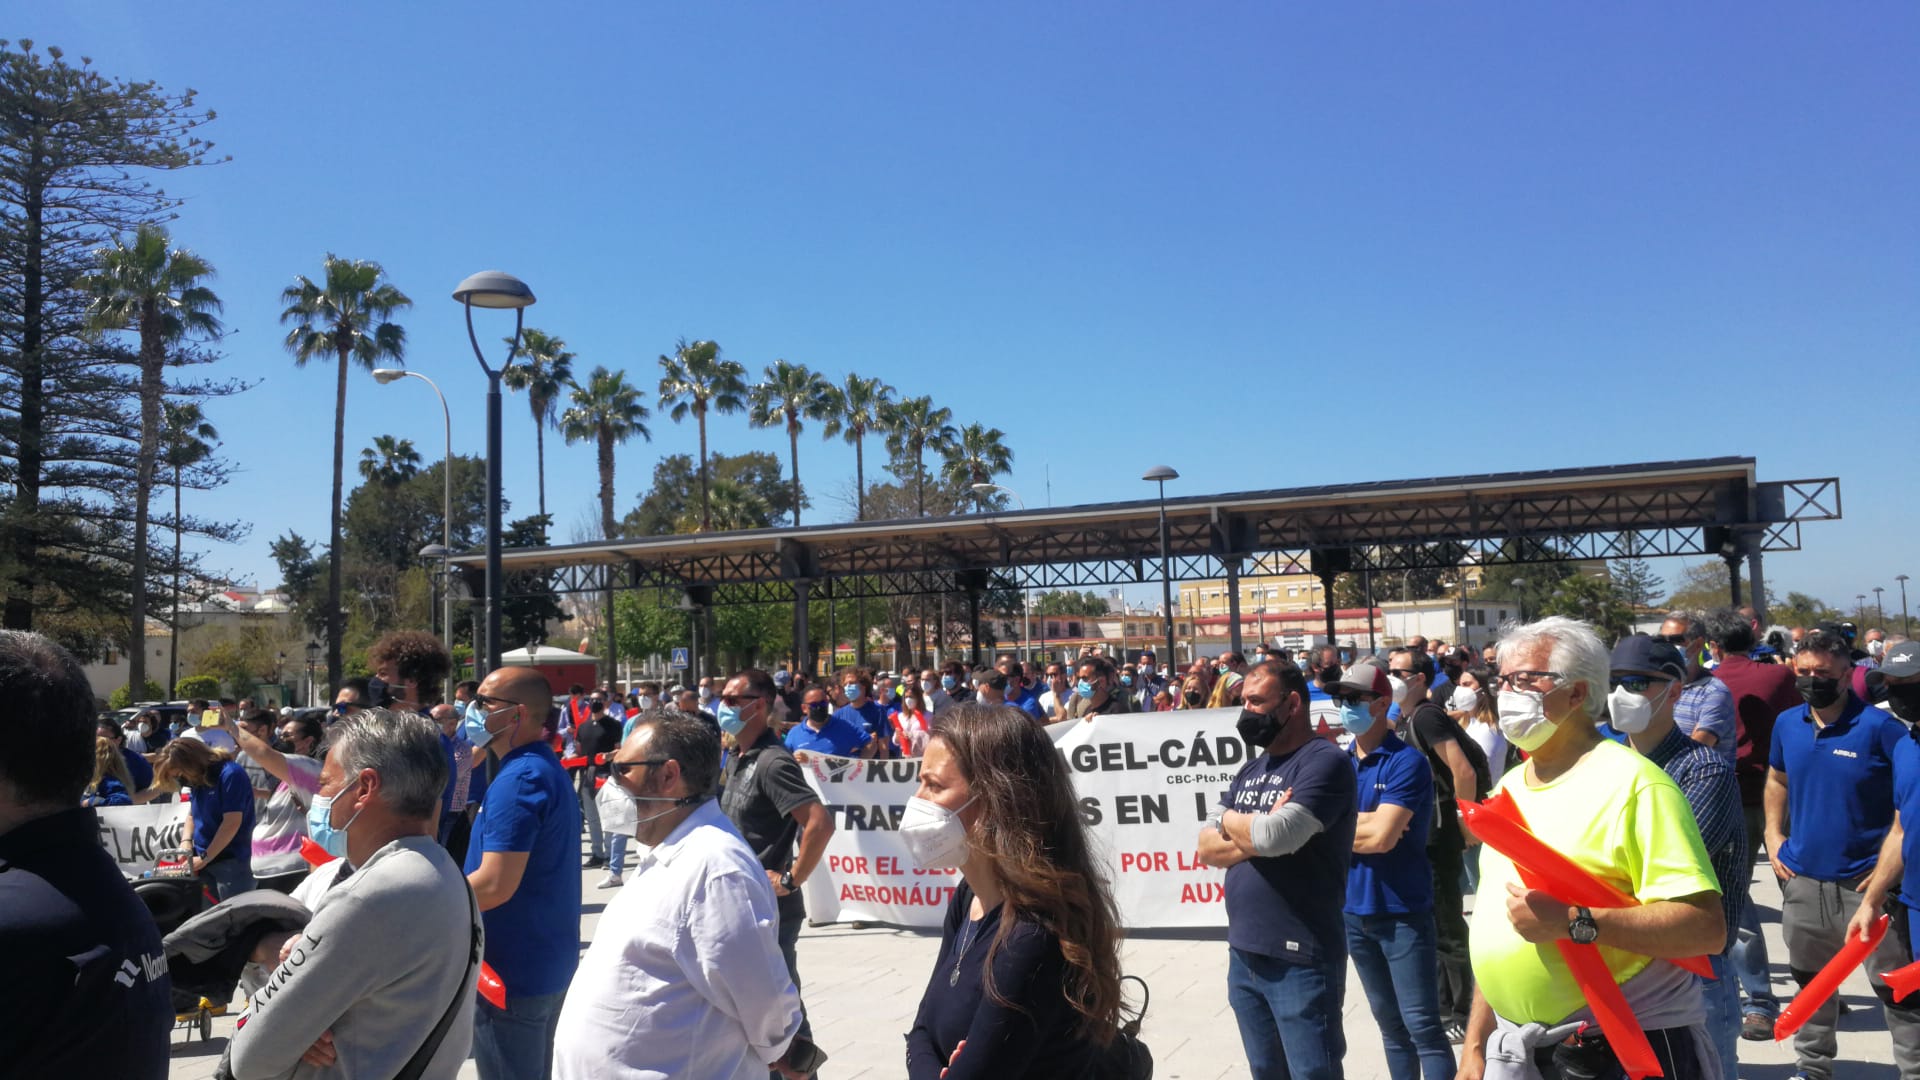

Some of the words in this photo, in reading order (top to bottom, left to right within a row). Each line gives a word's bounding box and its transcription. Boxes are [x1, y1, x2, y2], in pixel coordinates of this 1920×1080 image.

[866, 760, 922, 783] KU
[1115, 793, 1170, 825] EN
[829, 855, 869, 875] POR
[875, 856, 904, 876] EL
[1121, 852, 1170, 872] POR
[253, 934, 323, 1014] TOMMY
